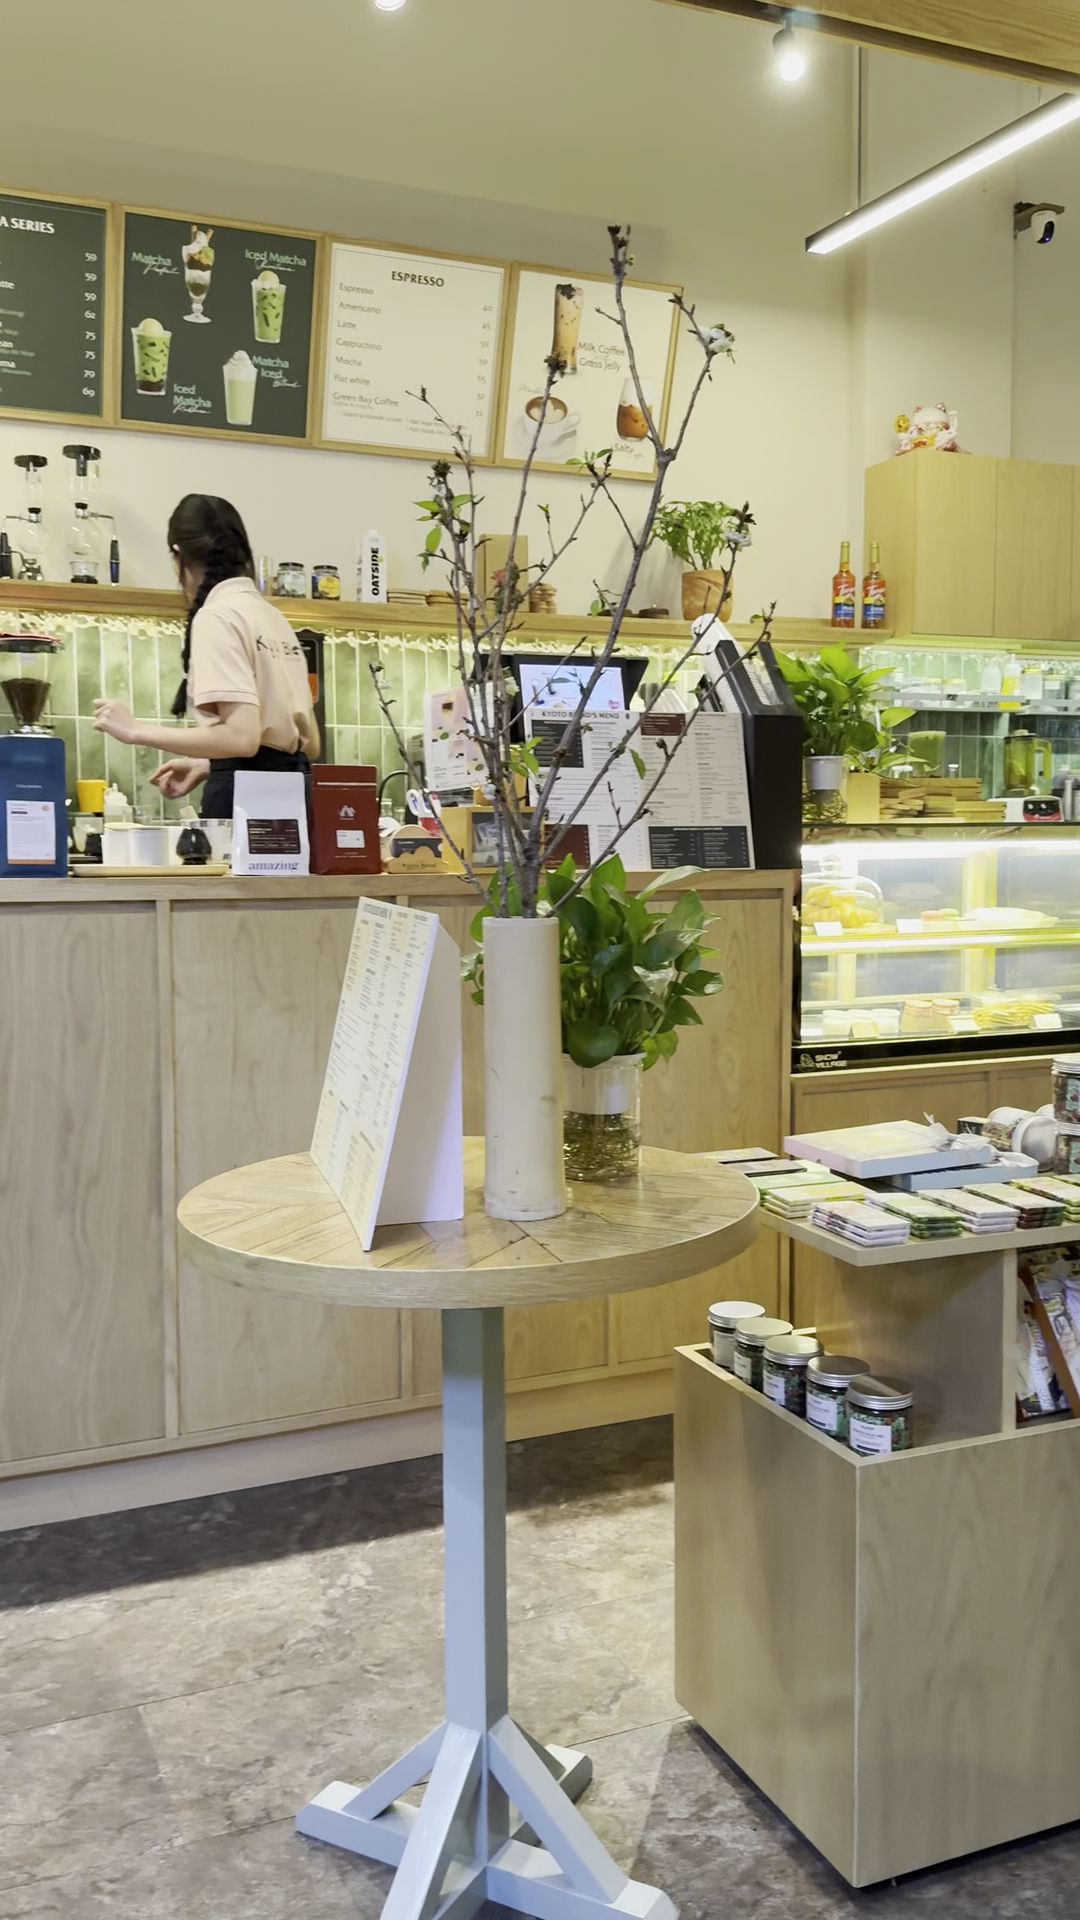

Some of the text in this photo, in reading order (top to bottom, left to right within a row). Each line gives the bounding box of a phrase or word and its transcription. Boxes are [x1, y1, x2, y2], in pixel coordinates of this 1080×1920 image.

[10, 217, 56, 234] SERIES
[85, 253, 97, 262] 59
[132, 252, 172, 266] Matcha
[245, 249, 307, 267] Iced Matcha
[85, 272, 97, 282] 59
[391, 271, 445, 288] ESPRESSO
[339, 283, 374, 296] Espresso
[84, 292, 97, 302] 59
[338, 302, 382, 315] Americano
[337, 320, 357, 330] Latte
[85, 331, 96, 341] 75
[578, 342, 626, 357] Milk Coffee
[84, 351, 96, 360] 75
[252, 355, 290, 369] Matcha
[335, 356, 362, 367] Mocha
[579, 357, 622, 372] Grass Jelly
[83, 369, 95, 379] 79
[261, 369, 283, 380] Iced
[349, 376, 371, 386] white
[82, 387, 95, 398] 69
[173, 384, 196, 394] Iced
[173, 396, 212, 408] Matcha
[333, 392, 399, 407] Green Bay Coffee
[371, 547, 380, 596] OATSIDE
[568, 711, 597, 719] BND'S
[598, 712, 620, 720] MENU
[248, 860, 299, 872] amazing
[815, 1060, 847, 1068] VILLAGE
